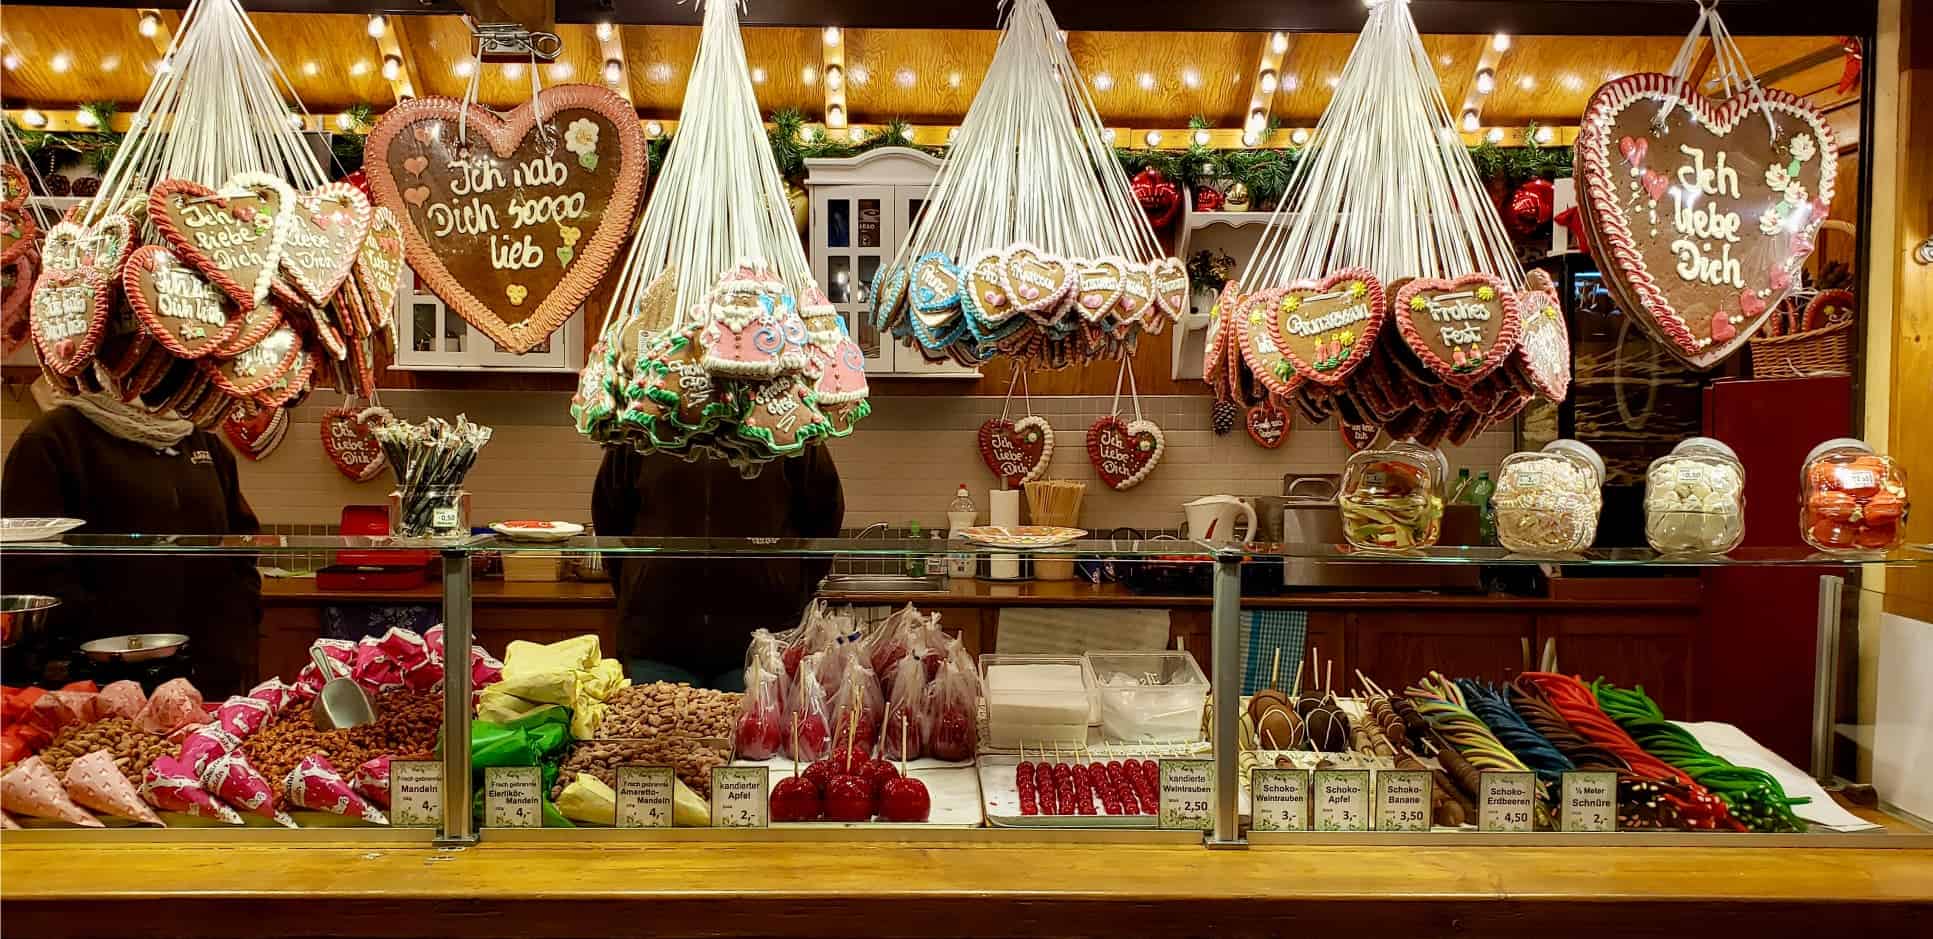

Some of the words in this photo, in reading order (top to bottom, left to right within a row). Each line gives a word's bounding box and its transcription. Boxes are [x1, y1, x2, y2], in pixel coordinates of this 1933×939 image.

[448, 155, 506, 196] Ich
[1677, 143, 1741, 199] Ich
[180, 204, 234, 228] Ich
[427, 198, 499, 237] Dich
[508, 191, 586, 230] soooo
[1671, 191, 1742, 242] liebe
[195, 225, 258, 250] liebe
[490, 234, 544, 270] lieb
[213, 246, 264, 271] Dich
[1671, 238, 1746, 289] Dich
[1425, 298, 1491, 322] Frohes
[1440, 321, 1482, 347] Fest
[991, 433, 1014, 450] Ich
[1101, 430, 1125, 450] Ich
[993, 448, 1024, 462] liebe
[1100, 443, 1129, 464] liebe
[1000, 461, 1028, 477] Dich
[1102, 461, 1131, 476] Dich
[1168, 775, 1206, 783] kandierte
[401, 785, 438, 793] Mandeln
[720, 782, 760, 790] kandierter
[1163, 784, 1211, 793] Weintrauben
[1263, 784, 1298, 793] Schoko-
[1326, 786, 1361, 794] Schoko-
[1387, 785, 1422, 793] Schoko-
[620, 788, 659, 796] Amaretto-
[728, 791, 751, 801] Apfel
[1490, 788, 1525, 796] Schoko-
[506, 797, 539, 805] Mandeln
[637, 797, 670, 805] Mandeln
[1328, 795, 1351, 804] Apfel
[1388, 796, 1420, 804] Banane
[1487, 797, 1531, 806] Erdbeeren
[1572, 798, 1611, 808] Schnüre
[422, 801, 438, 812] 4,-
[1184, 801, 1208, 812] 2,50
[516, 807, 531, 819] 4,-
[649, 808, 664, 819] 4,-
[740, 810, 756, 821] 2,-
[1281, 810, 1297, 821] 3,-
[1343, 810, 1357, 821] 3,-
[1400, 811, 1424, 822] 3,50
[1504, 812, 1528, 824] 4,50
[1593, 813, 1608, 825] 2,-
